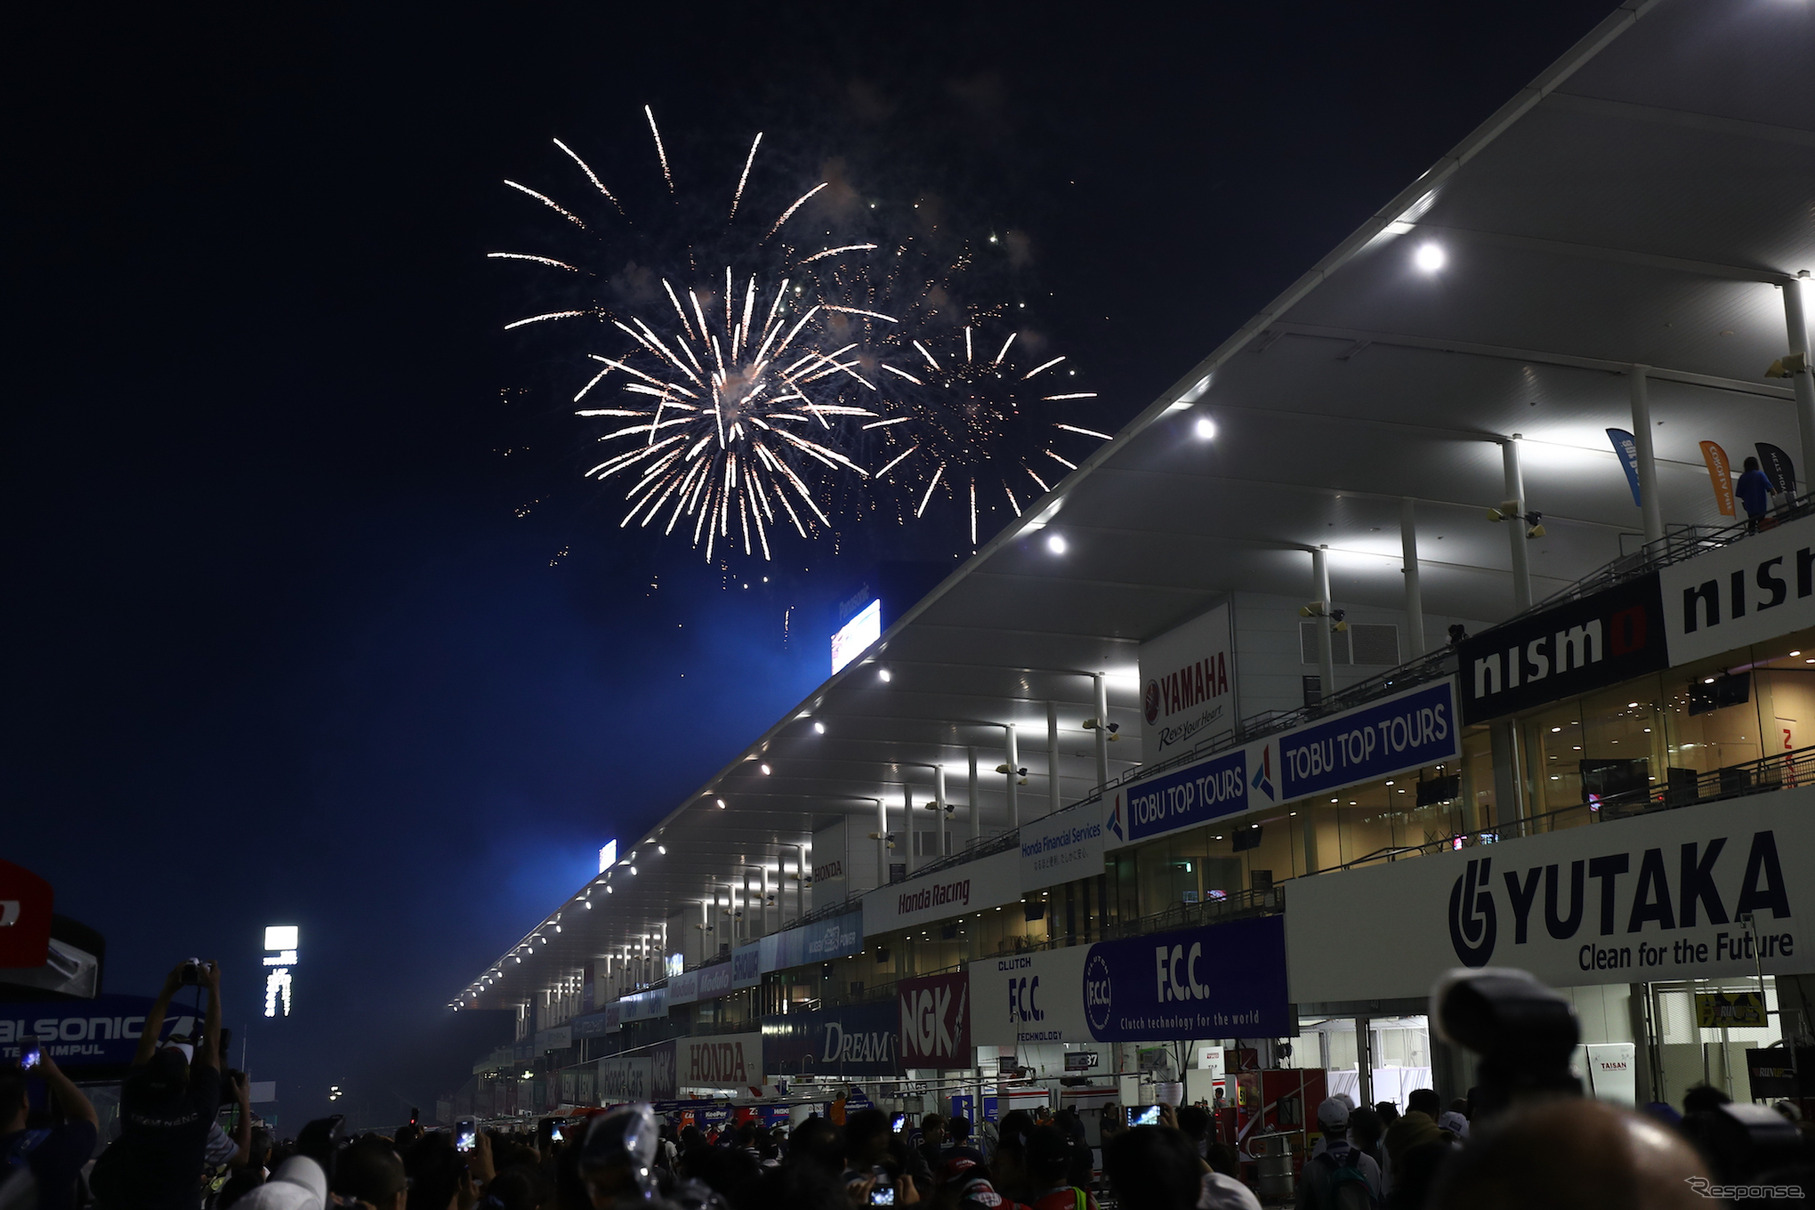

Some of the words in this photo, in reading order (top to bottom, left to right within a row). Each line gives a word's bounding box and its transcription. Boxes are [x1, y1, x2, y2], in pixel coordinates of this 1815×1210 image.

[1474, 605, 1646, 699] nismo
[1161, 651, 1228, 716] YAMAHA
[1158, 723, 1183, 752] Revs
[1183, 718, 1200, 741] Your
[1201, 705, 1222, 725] Heart
[1286, 743, 1335, 782] TOBU
[1337, 728, 1376, 768] TOP
[1378, 703, 1447, 753] TOURS
[1131, 791, 1165, 825] TOBU
[1167, 783, 1196, 817] TOP
[1197, 765, 1242, 808] TOURS
[1021, 839, 1042, 858] Honda
[1043, 829, 1071, 852] Financial
[1072, 823, 1101, 843] Services
[814, 860, 842, 884] HONDA
[1503, 830, 1791, 944] YUTAKA
[898, 888, 930, 915] Honda
[932, 879, 970, 907] Racing
[998, 957, 1031, 971] CLUTCH
[1156, 942, 1210, 1002] F.C.C.
[1579, 944, 1631, 971] Clean
[1638, 941, 1667, 966] for
[1673, 938, 1707, 963] the
[1716, 932, 1793, 961] Future
[1008, 976, 1044, 1022] F.C.C.
[902, 982, 953, 1059] NGK
[1017, 1031, 1062, 1041] TECHNOLOGY
[1120, 1017, 1145, 1030] Clutch
[1147, 1014, 1193, 1030] technology
[1197, 1013, 1210, 1026] for
[1214, 1012, 1229, 1025] the
[1233, 1010, 1260, 1024] world
[50, 1044, 104, 1056] IMPUL
[689, 1042, 746, 1084] HONDA
[627, 1062, 643, 1098] Cars
[653, 1051, 671, 1091] NGK
